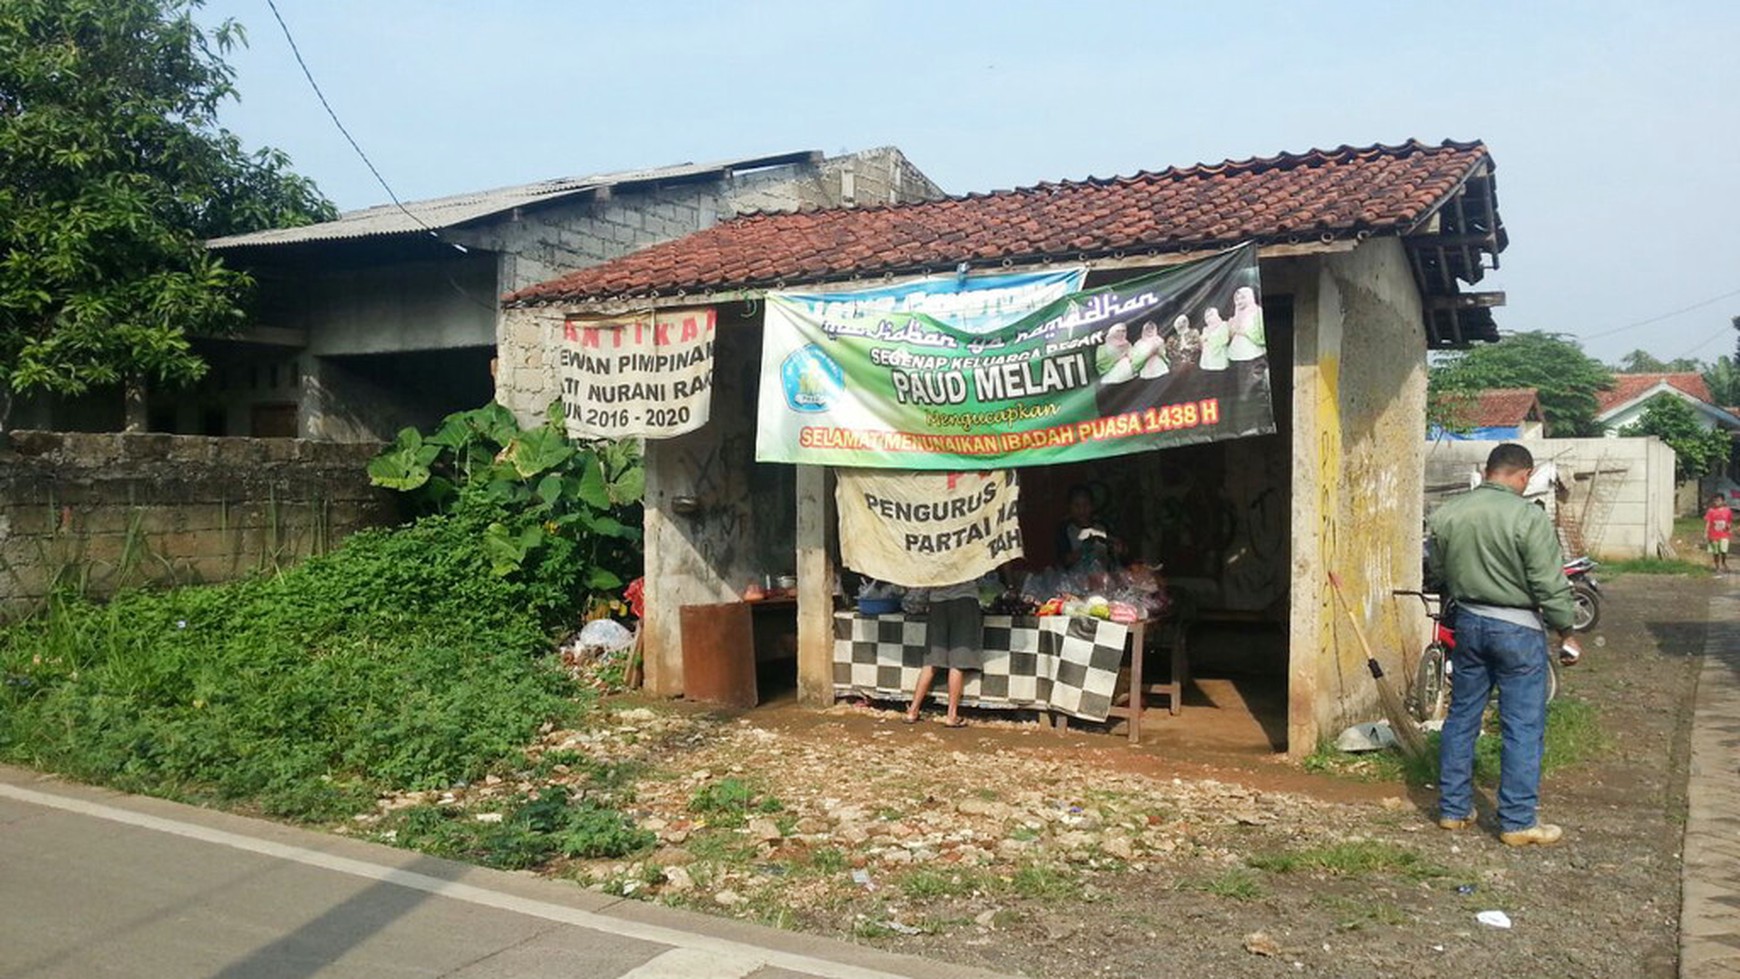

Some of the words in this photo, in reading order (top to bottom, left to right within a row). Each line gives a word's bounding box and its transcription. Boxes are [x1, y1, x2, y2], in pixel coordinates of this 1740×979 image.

[871, 347, 948, 370] SEGENAP
[951, 348, 1040, 369] KELUARGA
[587, 383, 666, 403] NURANI
[892, 369, 967, 404] PAUD
[973, 352, 1088, 401] MELATI
[586, 409, 629, 428] 2016
[646, 406, 690, 427] 2020
[800, 427, 881, 449] SELAMAT
[884, 431, 1000, 453] MENUNAIKAN
[1002, 425, 1074, 451] IBADAH
[1078, 413, 1142, 441] PUASA
[1146, 404, 1197, 430] 1438
[1202, 400, 1218, 424] H
[924, 402, 1061, 430] Mengucapkan
[864, 481, 997, 522] PENGURUS
[904, 516, 991, 553] PARTAI
